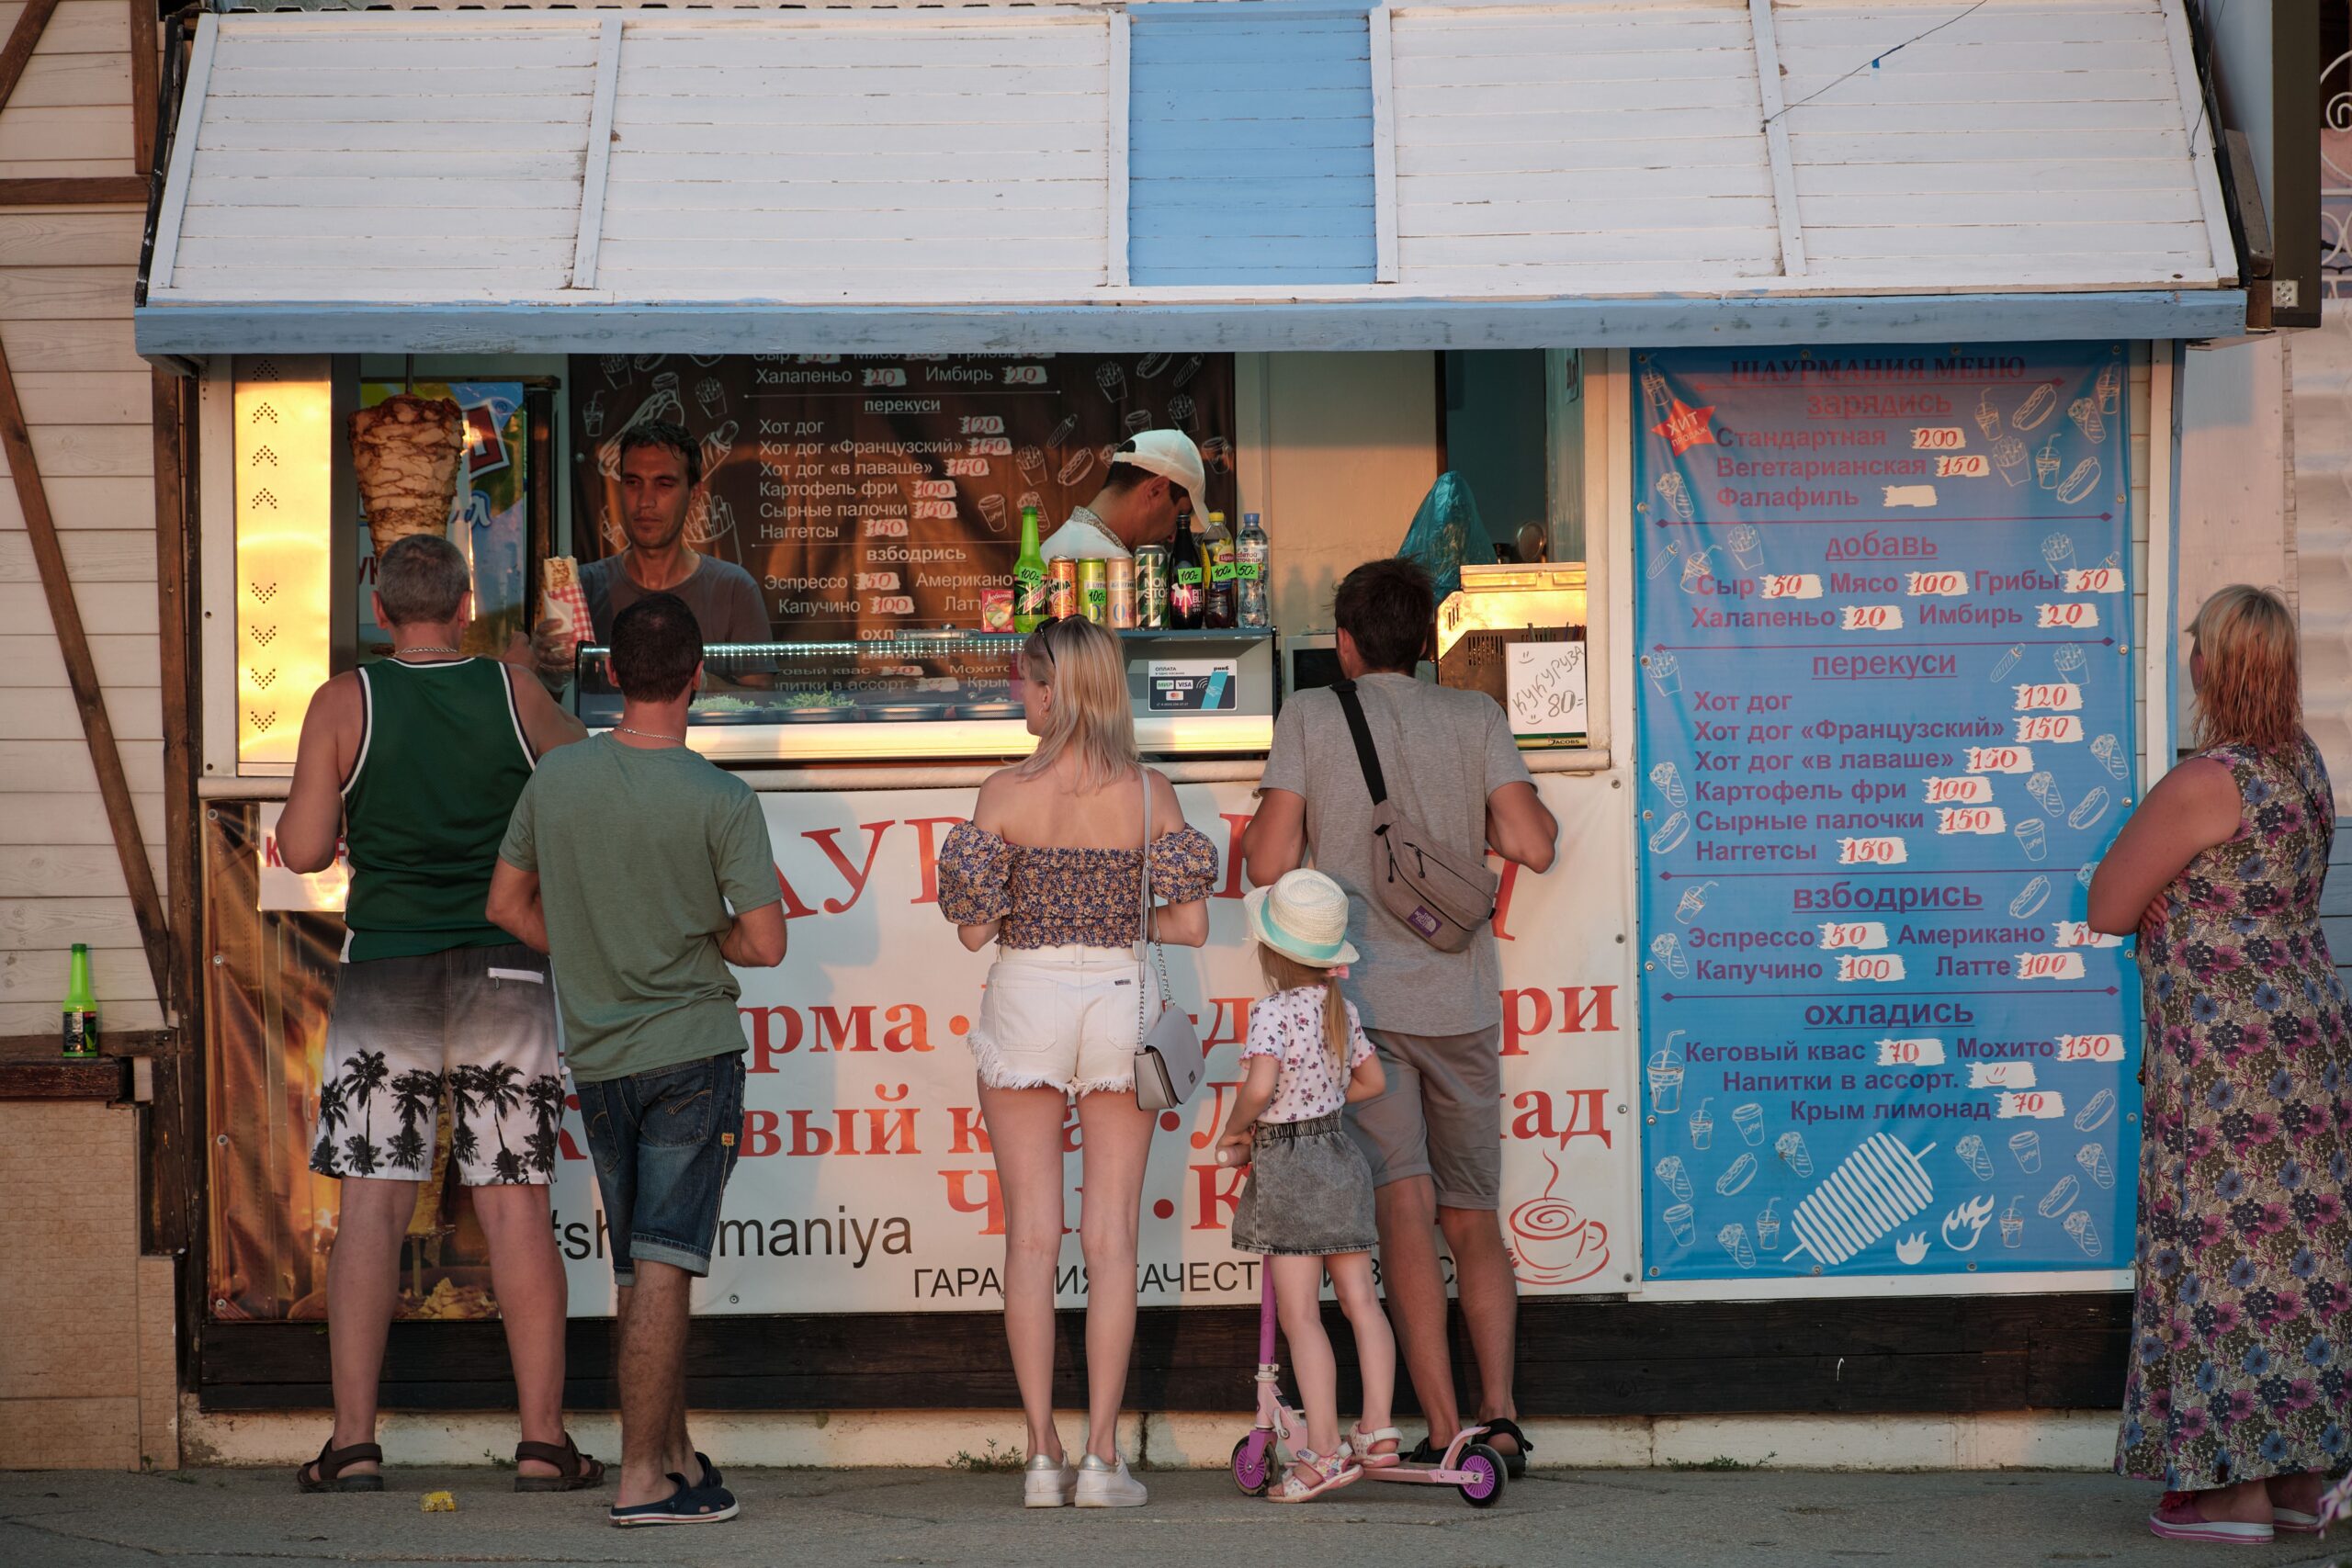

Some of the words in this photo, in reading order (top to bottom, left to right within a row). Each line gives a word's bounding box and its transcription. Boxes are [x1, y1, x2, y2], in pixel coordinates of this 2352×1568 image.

[756, 368, 852, 384] Халапеньо
[869, 368, 896, 385] 20
[926, 366, 993, 385] Имбирь
[1011, 367, 1037, 383] 20
[1733, 357, 1926, 382] ШАУРМАНИЯ
[1934, 355, 2026, 379] МЕНЮ
[864, 400, 941, 413] перекуси
[1807, 395, 1953, 418] зарядись
[760, 419, 790, 434] Хот
[795, 421, 825, 436] дог
[967, 417, 1000, 433] 120
[1667, 412, 1698, 436] ХИТ
[1672, 425, 1707, 447] ПРОДАЖ
[760, 440, 790, 456] Хот
[795, 442, 825, 458] дог
[831, 438, 962, 457] «Французский»
[1716, 427, 1887, 449] Стандартная
[1917, 429, 1958, 448] 200
[760, 461, 790, 477] Хот
[795, 463, 825, 479] дог
[831, 461, 852, 476] «в
[858, 461, 933, 476] лаваше»
[1716, 457, 1928, 479] Вегетарианская
[1941, 457, 1981, 476] 150
[760, 481, 855, 499] Картофель
[861, 480, 898, 499] фри
[916, 480, 949, 496] 100
[1716, 486, 1860, 507] Фалафиль
[760, 502, 832, 520] Сырные
[837, 502, 908, 516] палочки
[760, 524, 839, 539] Наггетсы
[866, 547, 967, 564] взбодрись
[1826, 532, 1938, 558] добавь
[764, 573, 848, 591] Эспрессо
[865, 572, 891, 588] 50
[915, 571, 1013, 588] Американо
[1144, 578, 1167, 588] NON
[1696, 575, 1755, 600] Сыр
[1771, 575, 1803, 596] 50
[1830, 574, 1899, 594] Мясо
[1913, 575, 1957, 594] 100
[1973, 570, 2061, 597] Грибы
[2075, 570, 2109, 591] 50
[778, 598, 860, 615] Капучино
[875, 597, 908, 613] 100
[944, 596, 981, 612] Латт
[1919, 603, 2023, 629] Имбирь
[2047, 604, 2083, 625] 20
[1691, 606, 1836, 629] Халапеньо
[1852, 607, 1887, 626] 20
[1812, 652, 1957, 676] перекуси
[1512, 646, 1585, 716] КУКУРУЗА
[1693, 692, 1741, 711] Хот
[1747, 694, 1792, 714] дог
[2022, 686, 2068, 709] 120
[1694, 721, 1741, 741] Хот
[1747, 723, 1793, 744] дог
[1801, 716, 2004, 743] «Французский»
[2024, 717, 2069, 740] 150
[1694, 751, 1741, 772] Хот
[1748, 753, 1794, 773] дог
[1801, 752, 1832, 770] «в
[1839, 751, 1954, 770] лаваше»
[1973, 749, 2018, 770] 150
[1695, 780, 1842, 805] Картофель
[1850, 778, 1907, 804] фри
[1931, 780, 1978, 800] 100
[1695, 811, 1807, 834] Сырные
[1815, 810, 1925, 829] палочки
[1944, 809, 1991, 830] 150
[1696, 841, 1817, 862] Наггетсы
[1846, 839, 1894, 863] 150
[1793, 882, 1983, 911] взбодрись
[1688, 927, 1815, 951] Эспрессо
[1828, 924, 1867, 946] 50
[1897, 922, 2045, 948] Американо
[1696, 960, 1824, 984] Капучино
[1845, 959, 1890, 981] 100
[1935, 955, 2011, 976] Латте
[2023, 954, 2067, 976] 100
[1499, 985, 1620, 1056] ри
[1804, 998, 1974, 1026] охладись
[1685, 1040, 1800, 1066] Кеговый
[1807, 1043, 1866, 1061] квас
[1891, 1042, 1920, 1064] 70
[1957, 1037, 2054, 1059] Мохито
[2064, 1036, 2110, 1060] 150
[1723, 1070, 1833, 1091] Напитки
[1841, 1074, 1857, 1090] в
[1863, 1072, 1959, 1095] ассорт.
[1791, 1101, 1866, 1124] Крым
[1873, 1100, 1991, 1122] лимонад
[2012, 1092, 2043, 1113] 70
